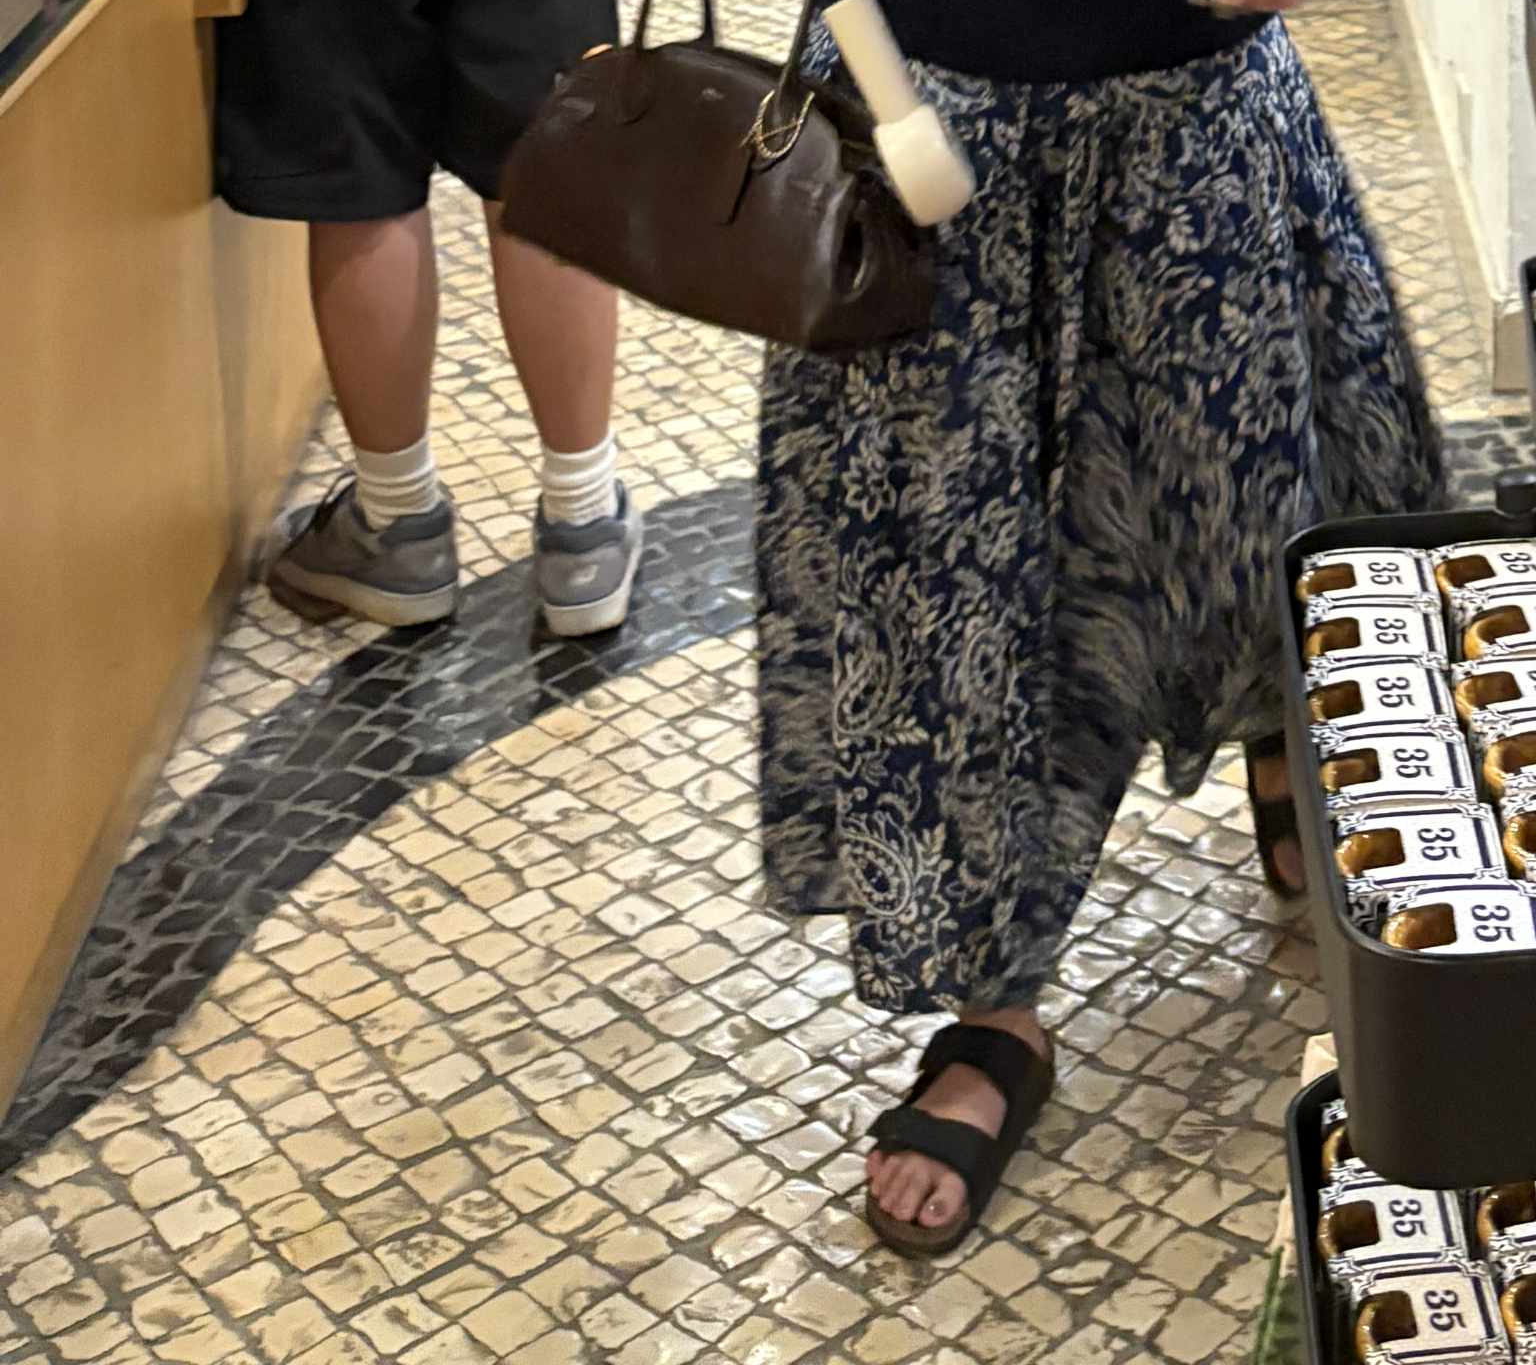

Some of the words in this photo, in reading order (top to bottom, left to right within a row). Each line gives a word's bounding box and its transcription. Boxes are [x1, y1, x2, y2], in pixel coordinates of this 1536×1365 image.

[1368, 563, 1399, 585] 35
[1500, 553, 1531, 573] 35
[1374, 618, 1406, 644] 35
[1376, 677, 1411, 707] 35
[1394, 749, 1429, 778] 35
[1418, 828, 1460, 861] 35
[1472, 905, 1513, 942] 35
[1389, 1200, 1426, 1237] 35
[1425, 1290, 1466, 1331] 35
